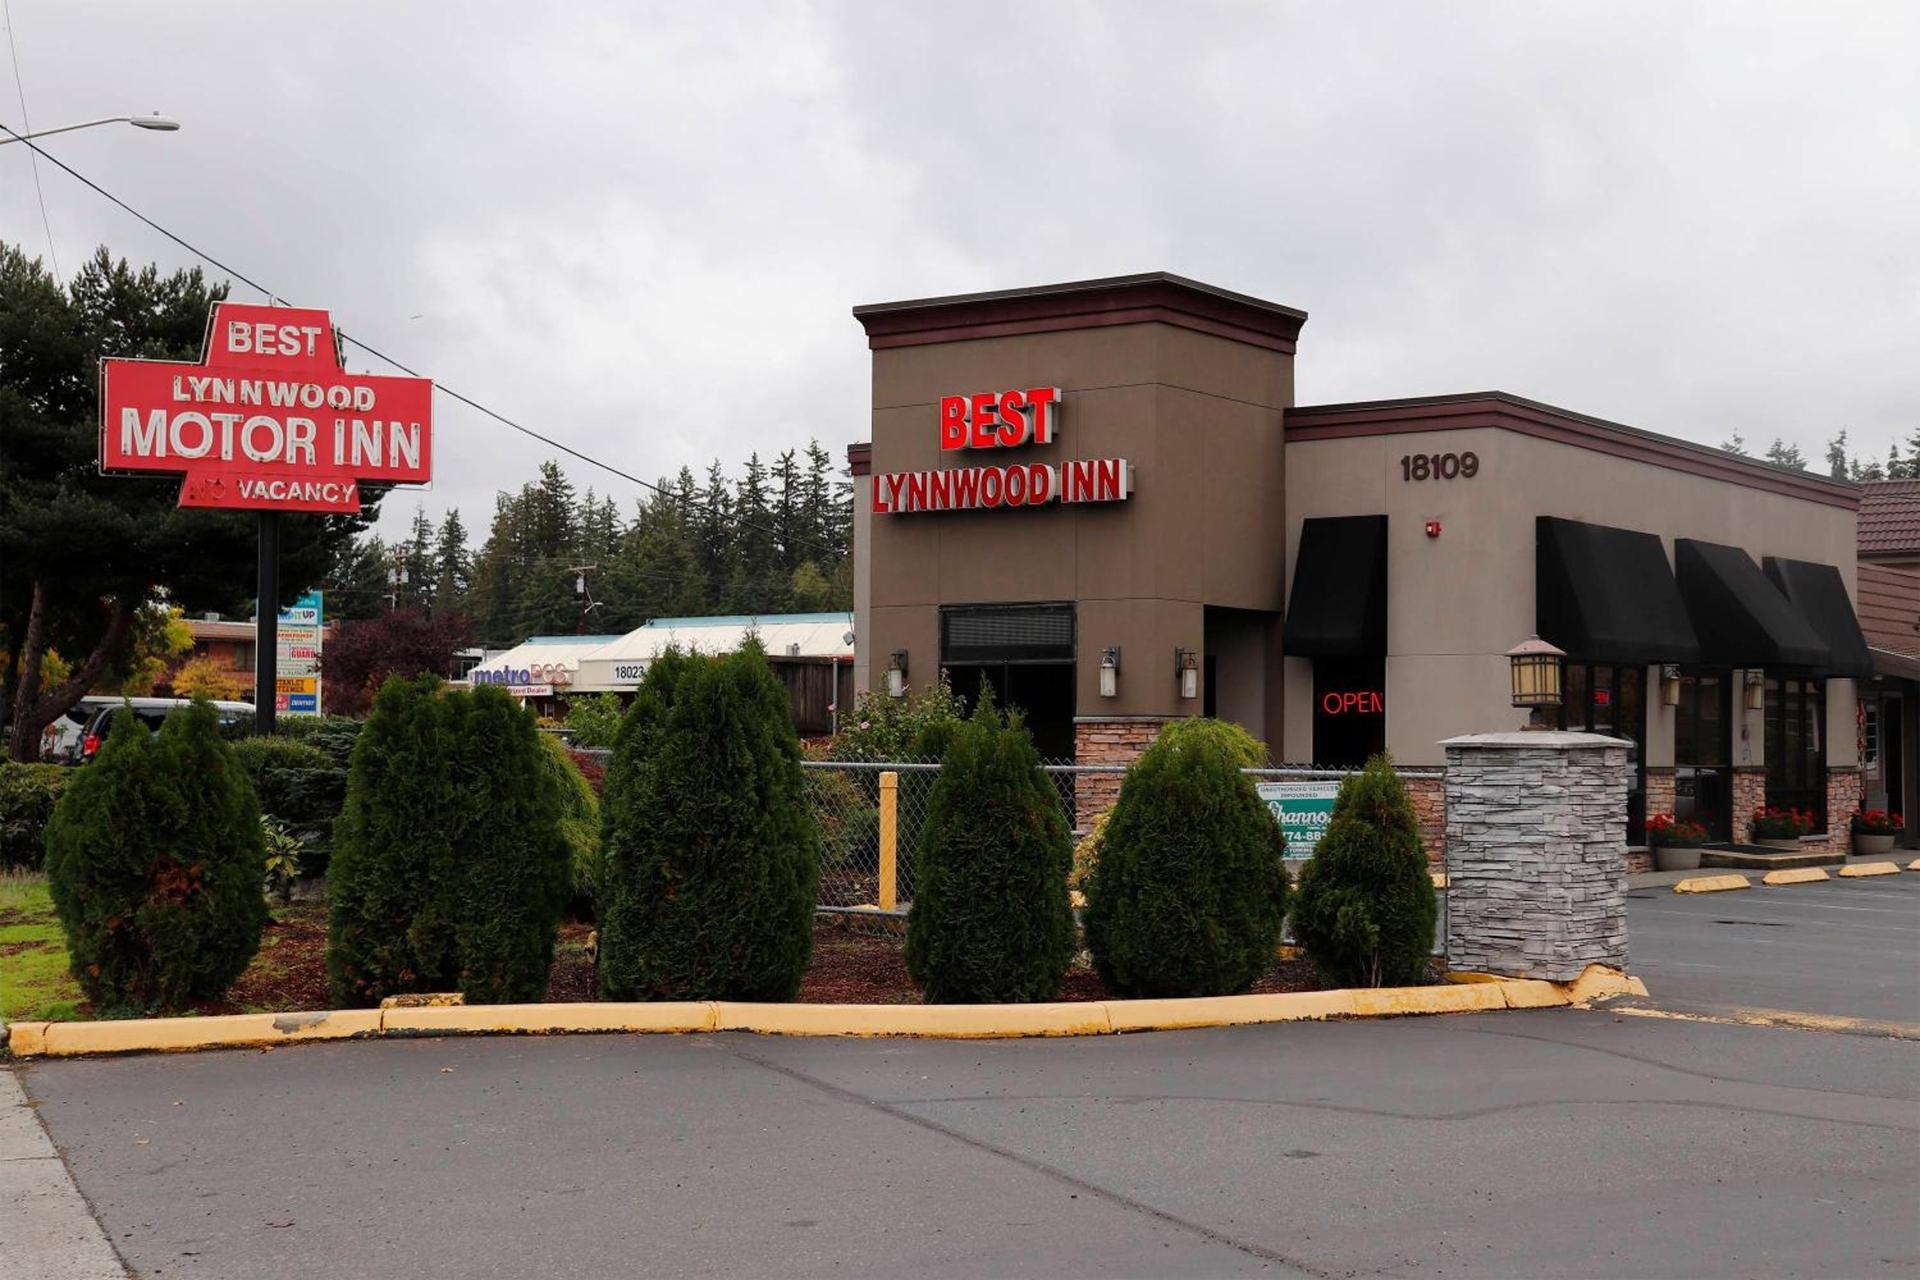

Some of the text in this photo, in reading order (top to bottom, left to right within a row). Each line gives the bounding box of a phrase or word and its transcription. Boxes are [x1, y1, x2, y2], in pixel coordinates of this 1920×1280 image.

[228, 322, 321, 357] BEST
[172, 375, 376, 412] LYNNWOOD
[941, 387, 1061, 450] BEST
[121, 407, 421, 469] MOTOR INN
[1401, 451, 1479, 482] 18109
[239, 479, 356, 503] VACANCY
[872, 459, 1127, 513] LYNNWOOD INN
[303, 610, 315, 619] UP
[474, 663, 567, 686] metroPCS
[615, 665, 645, 679] 18023
[1323, 691, 1384, 714] OPEN
[1266, 800, 1332, 826] Shanno
